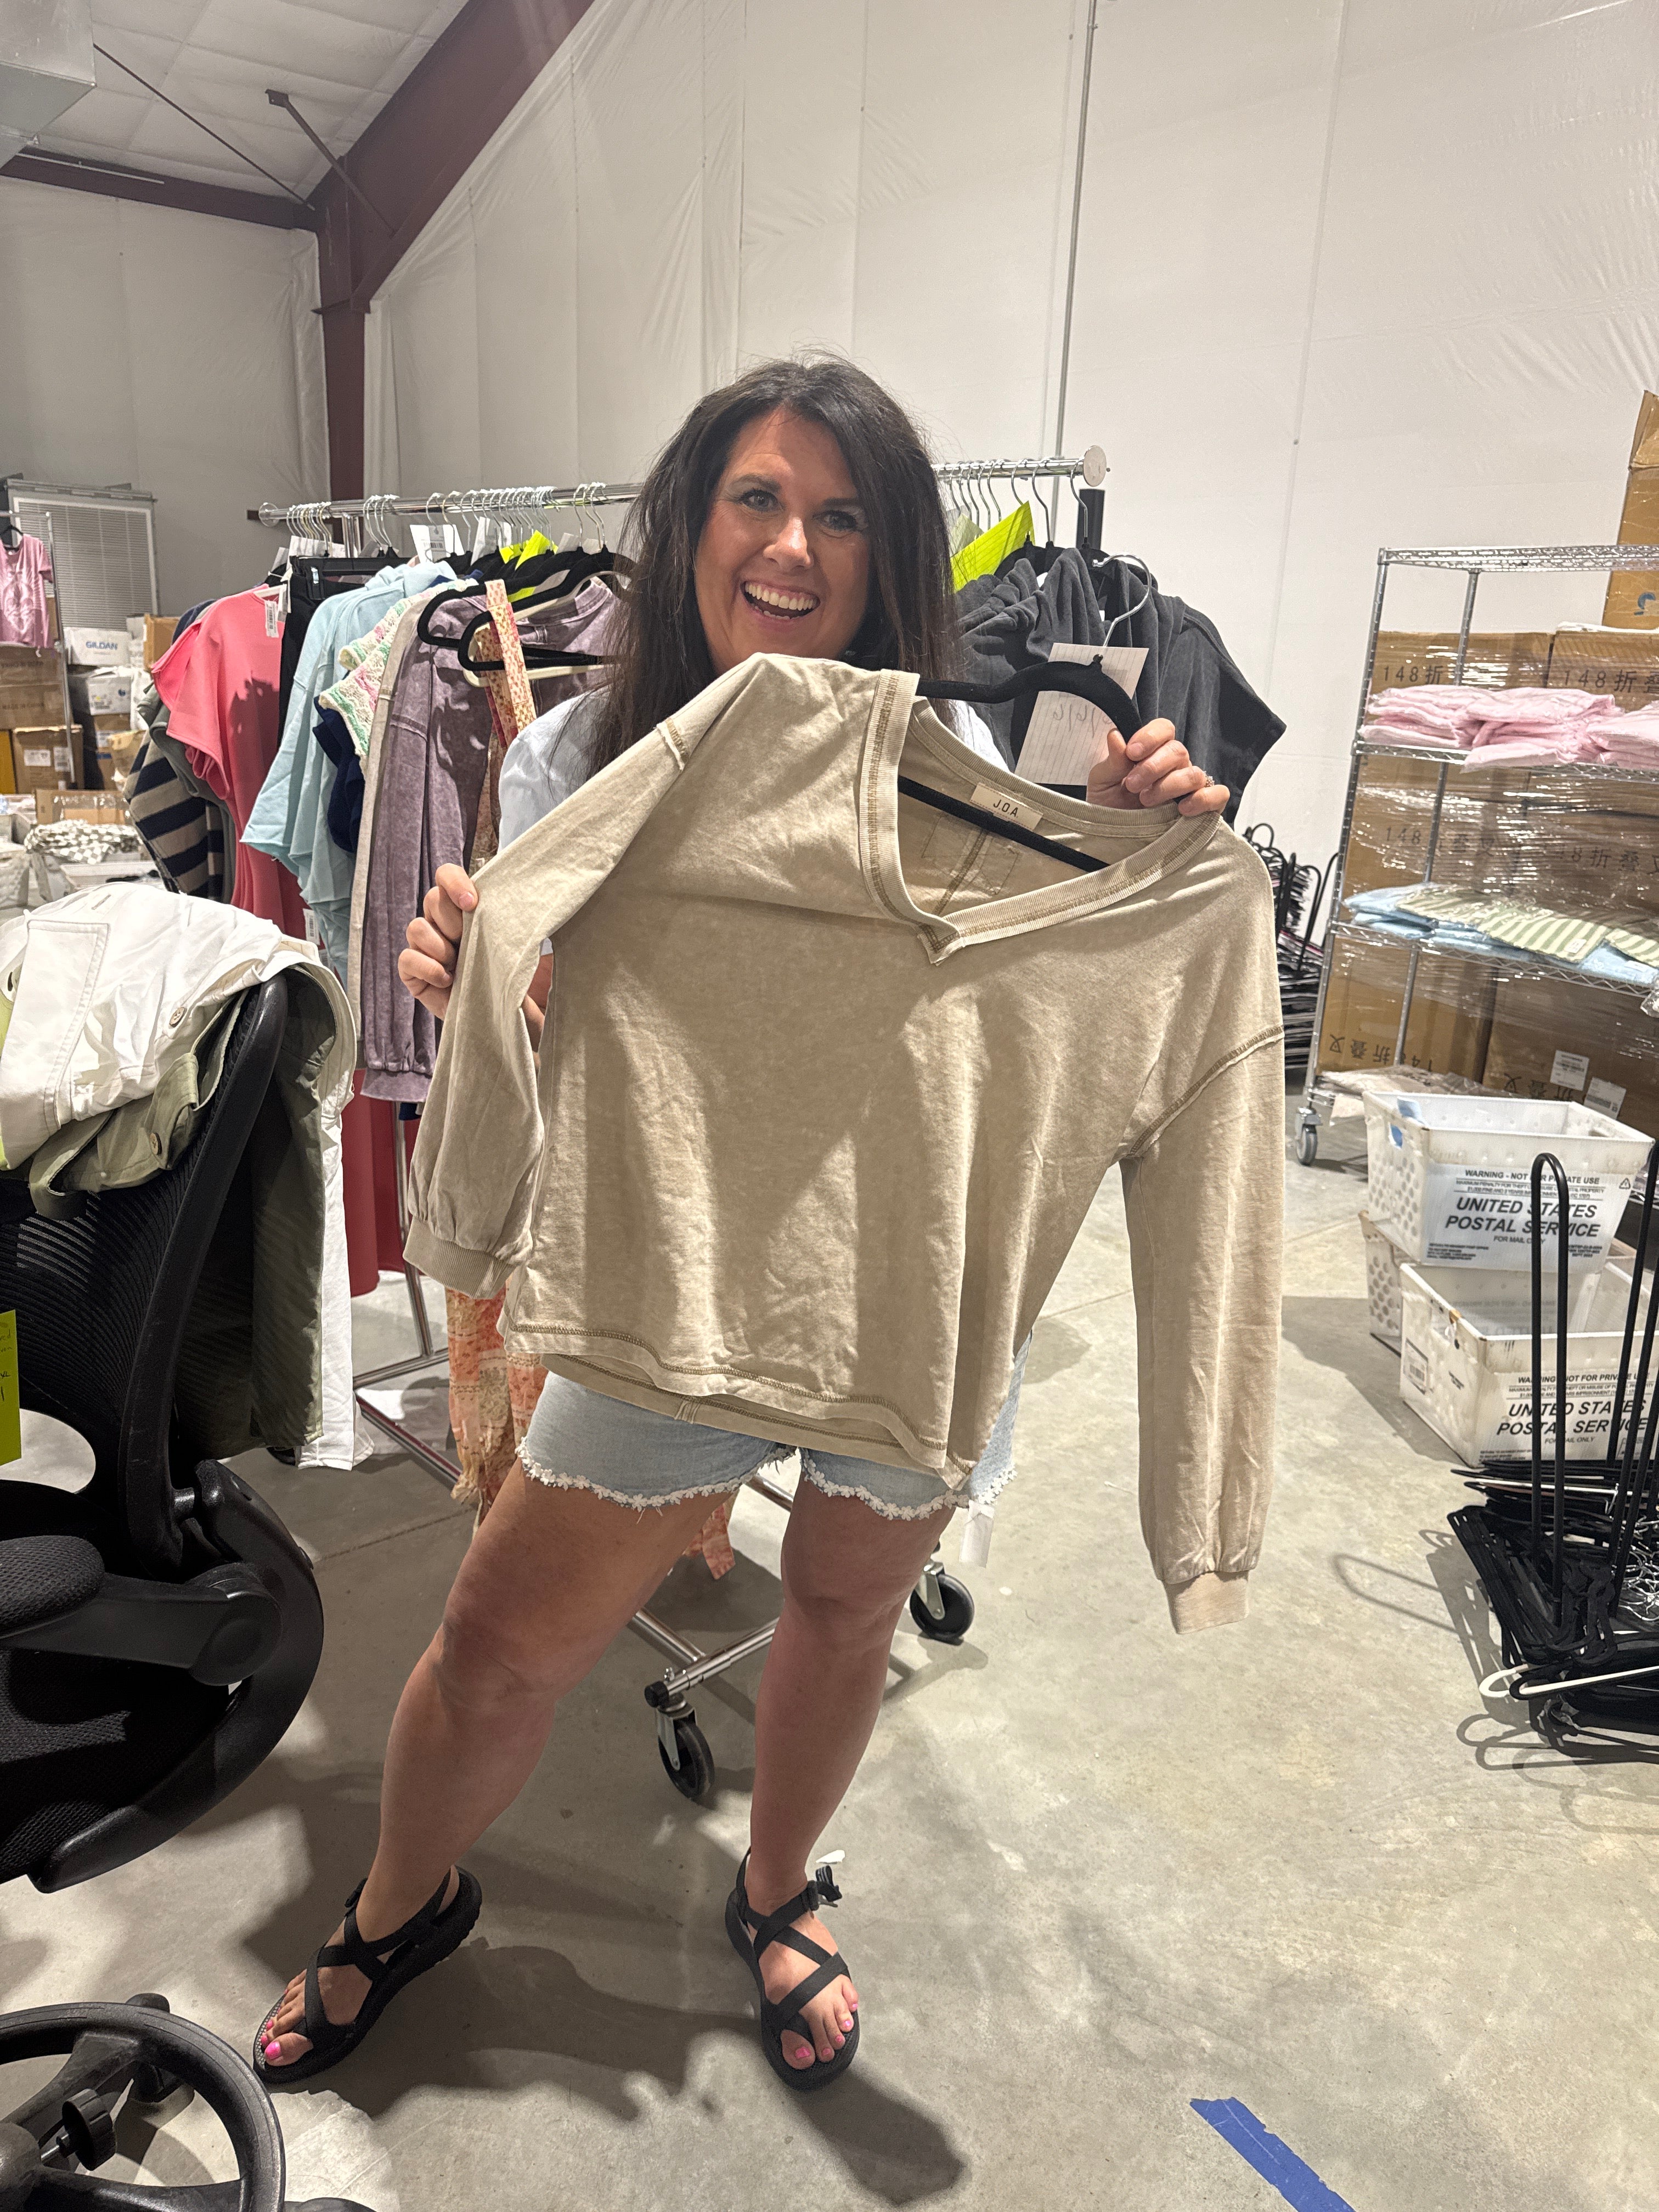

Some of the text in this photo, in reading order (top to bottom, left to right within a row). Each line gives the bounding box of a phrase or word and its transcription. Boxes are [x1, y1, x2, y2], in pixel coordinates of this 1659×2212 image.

[86, 641, 118, 650] GILDAN
[1465, 1170, 1503, 1178] WARNING
[1456, 1197, 1597, 1218] UNITED TAES
[1445, 1215, 1601, 1237] POSTAL SERICE
[1509, 1402, 1574, 1417] UNTED
[1497, 1421, 1567, 1435] POSA
